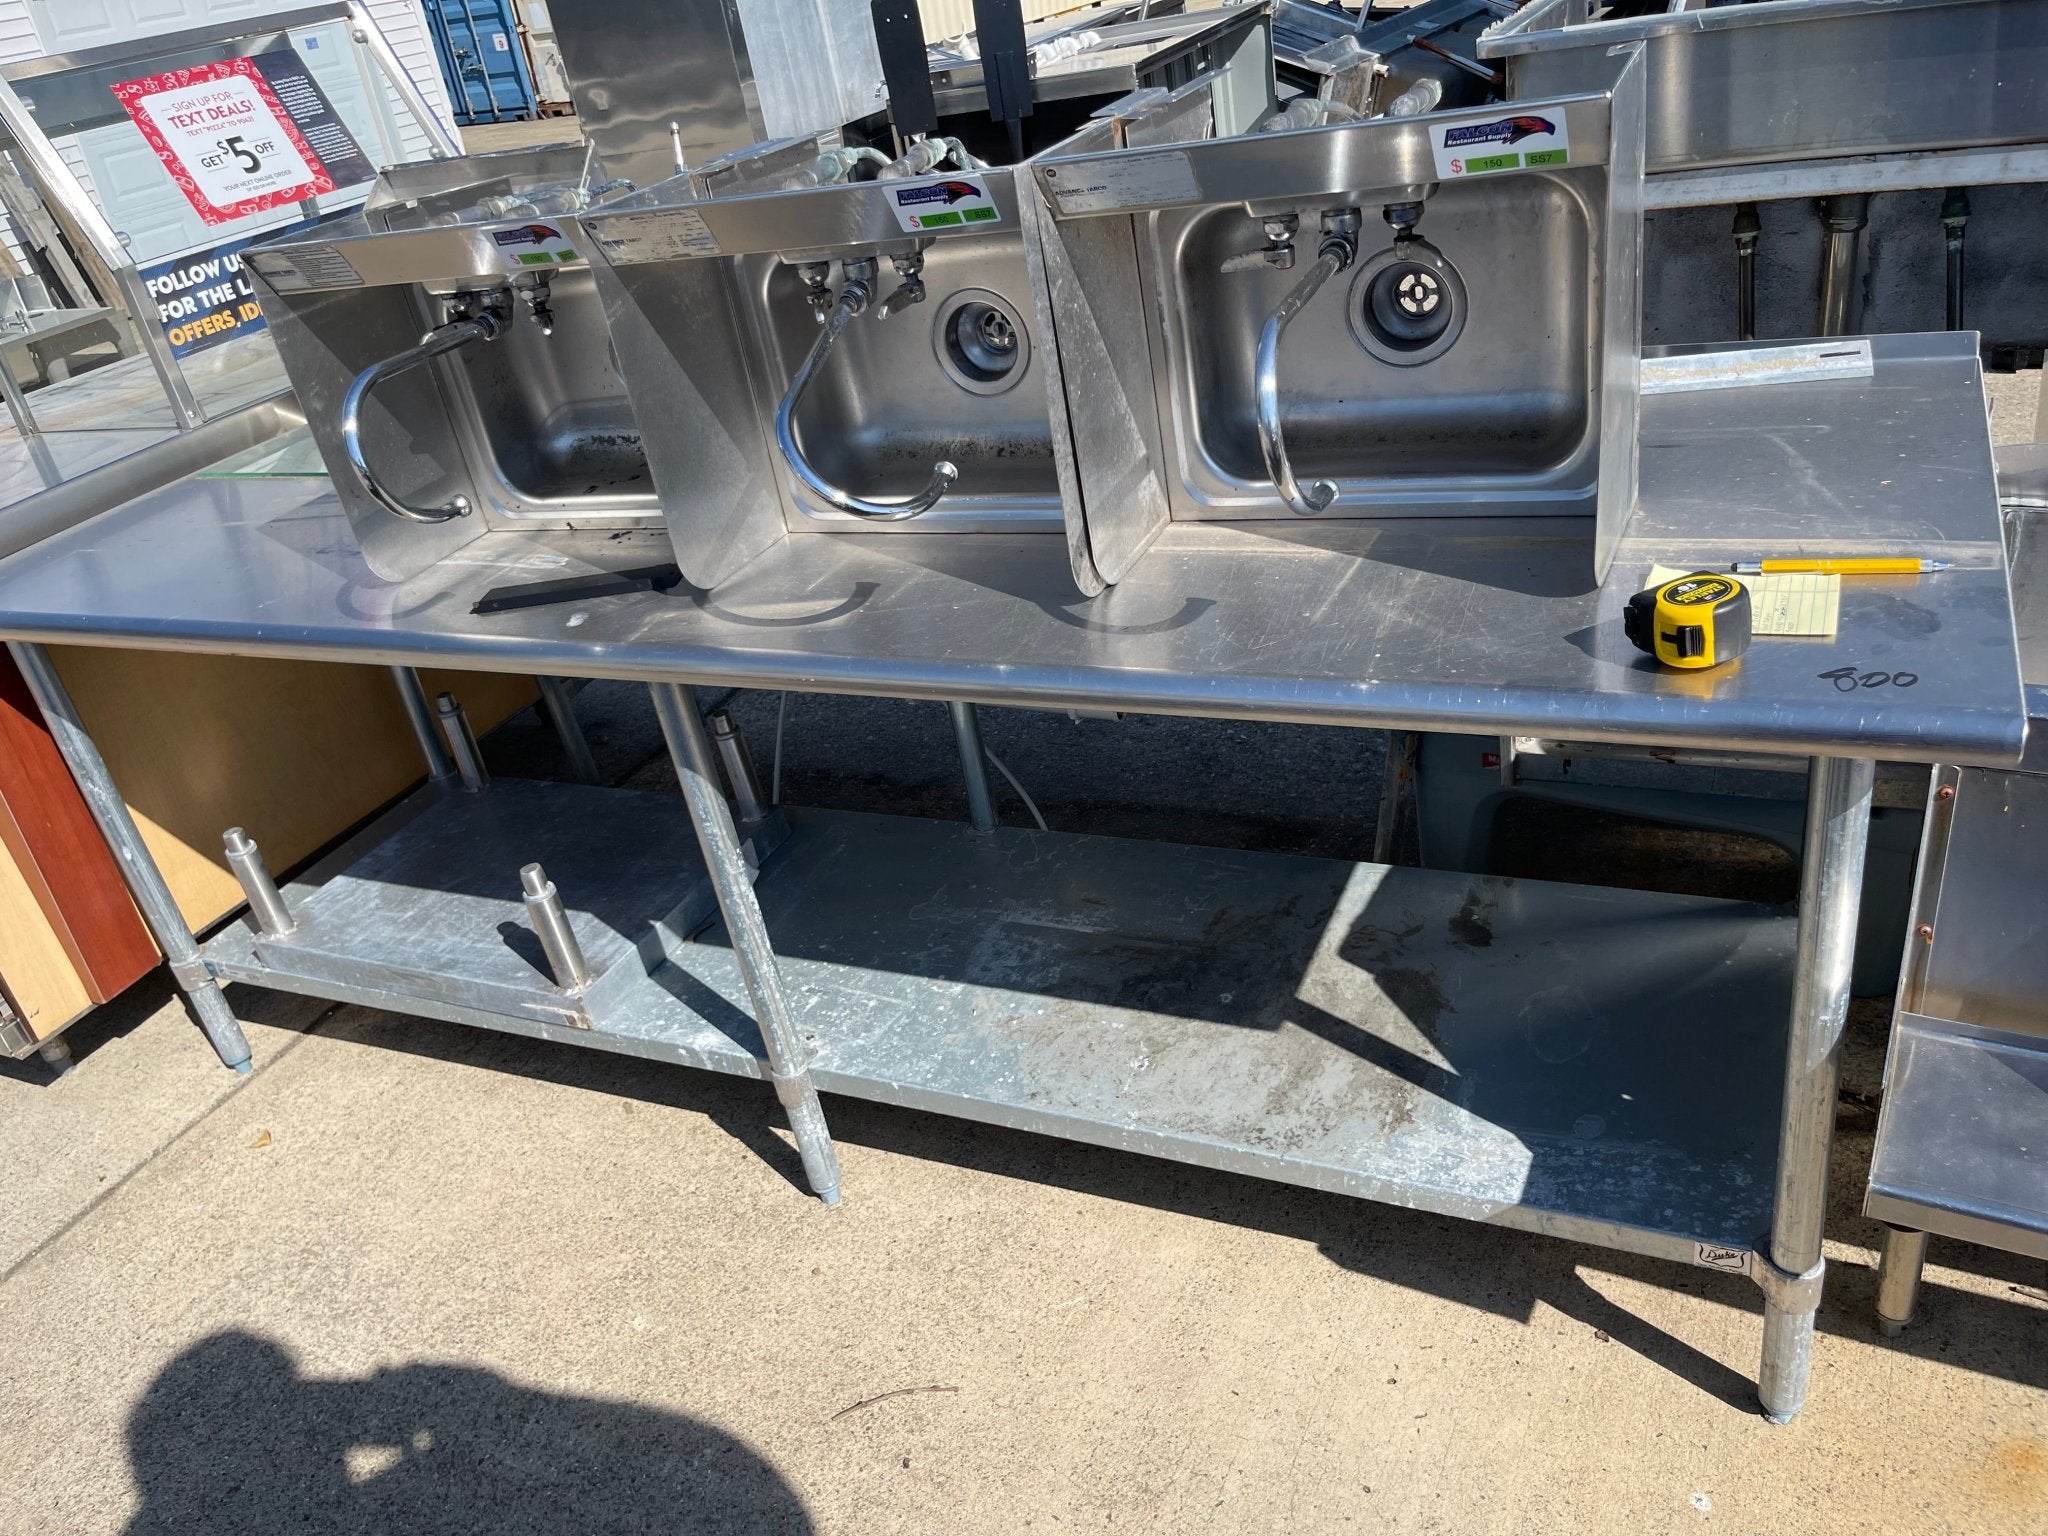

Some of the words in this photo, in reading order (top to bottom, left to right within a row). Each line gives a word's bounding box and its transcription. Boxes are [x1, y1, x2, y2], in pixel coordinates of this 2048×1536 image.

[172, 100, 196, 112] SIGN
[196, 96, 211, 106] UP
[212, 92, 234, 102] FOR
[168, 110, 206, 129] TEXT
[206, 99, 256, 120] DEALS!
[186, 128, 203, 136] TEXT
[1447, 136, 1486, 146] Restaurant
[1487, 132, 1512, 140] Supply
[1448, 121, 1514, 140] FALCON
[200, 154, 225, 168] GET
[254, 141, 276, 154] OFF
[1450, 158, 1462, 175] $
[1483, 158, 1502, 169] 150
[909, 215, 920, 228] $
[935, 216, 950, 224] 150
[146, 259, 220, 298] FOLLOW
[158, 296, 198, 323] FOR
[196, 282, 237, 308] THE
[236, 278, 254, 296] L
[168, 310, 241, 346] OFFERS,
[238, 301, 264, 322] ID
[1816, 666, 1919, 692] 800
[1705, 1250, 1738, 1260] Duke
